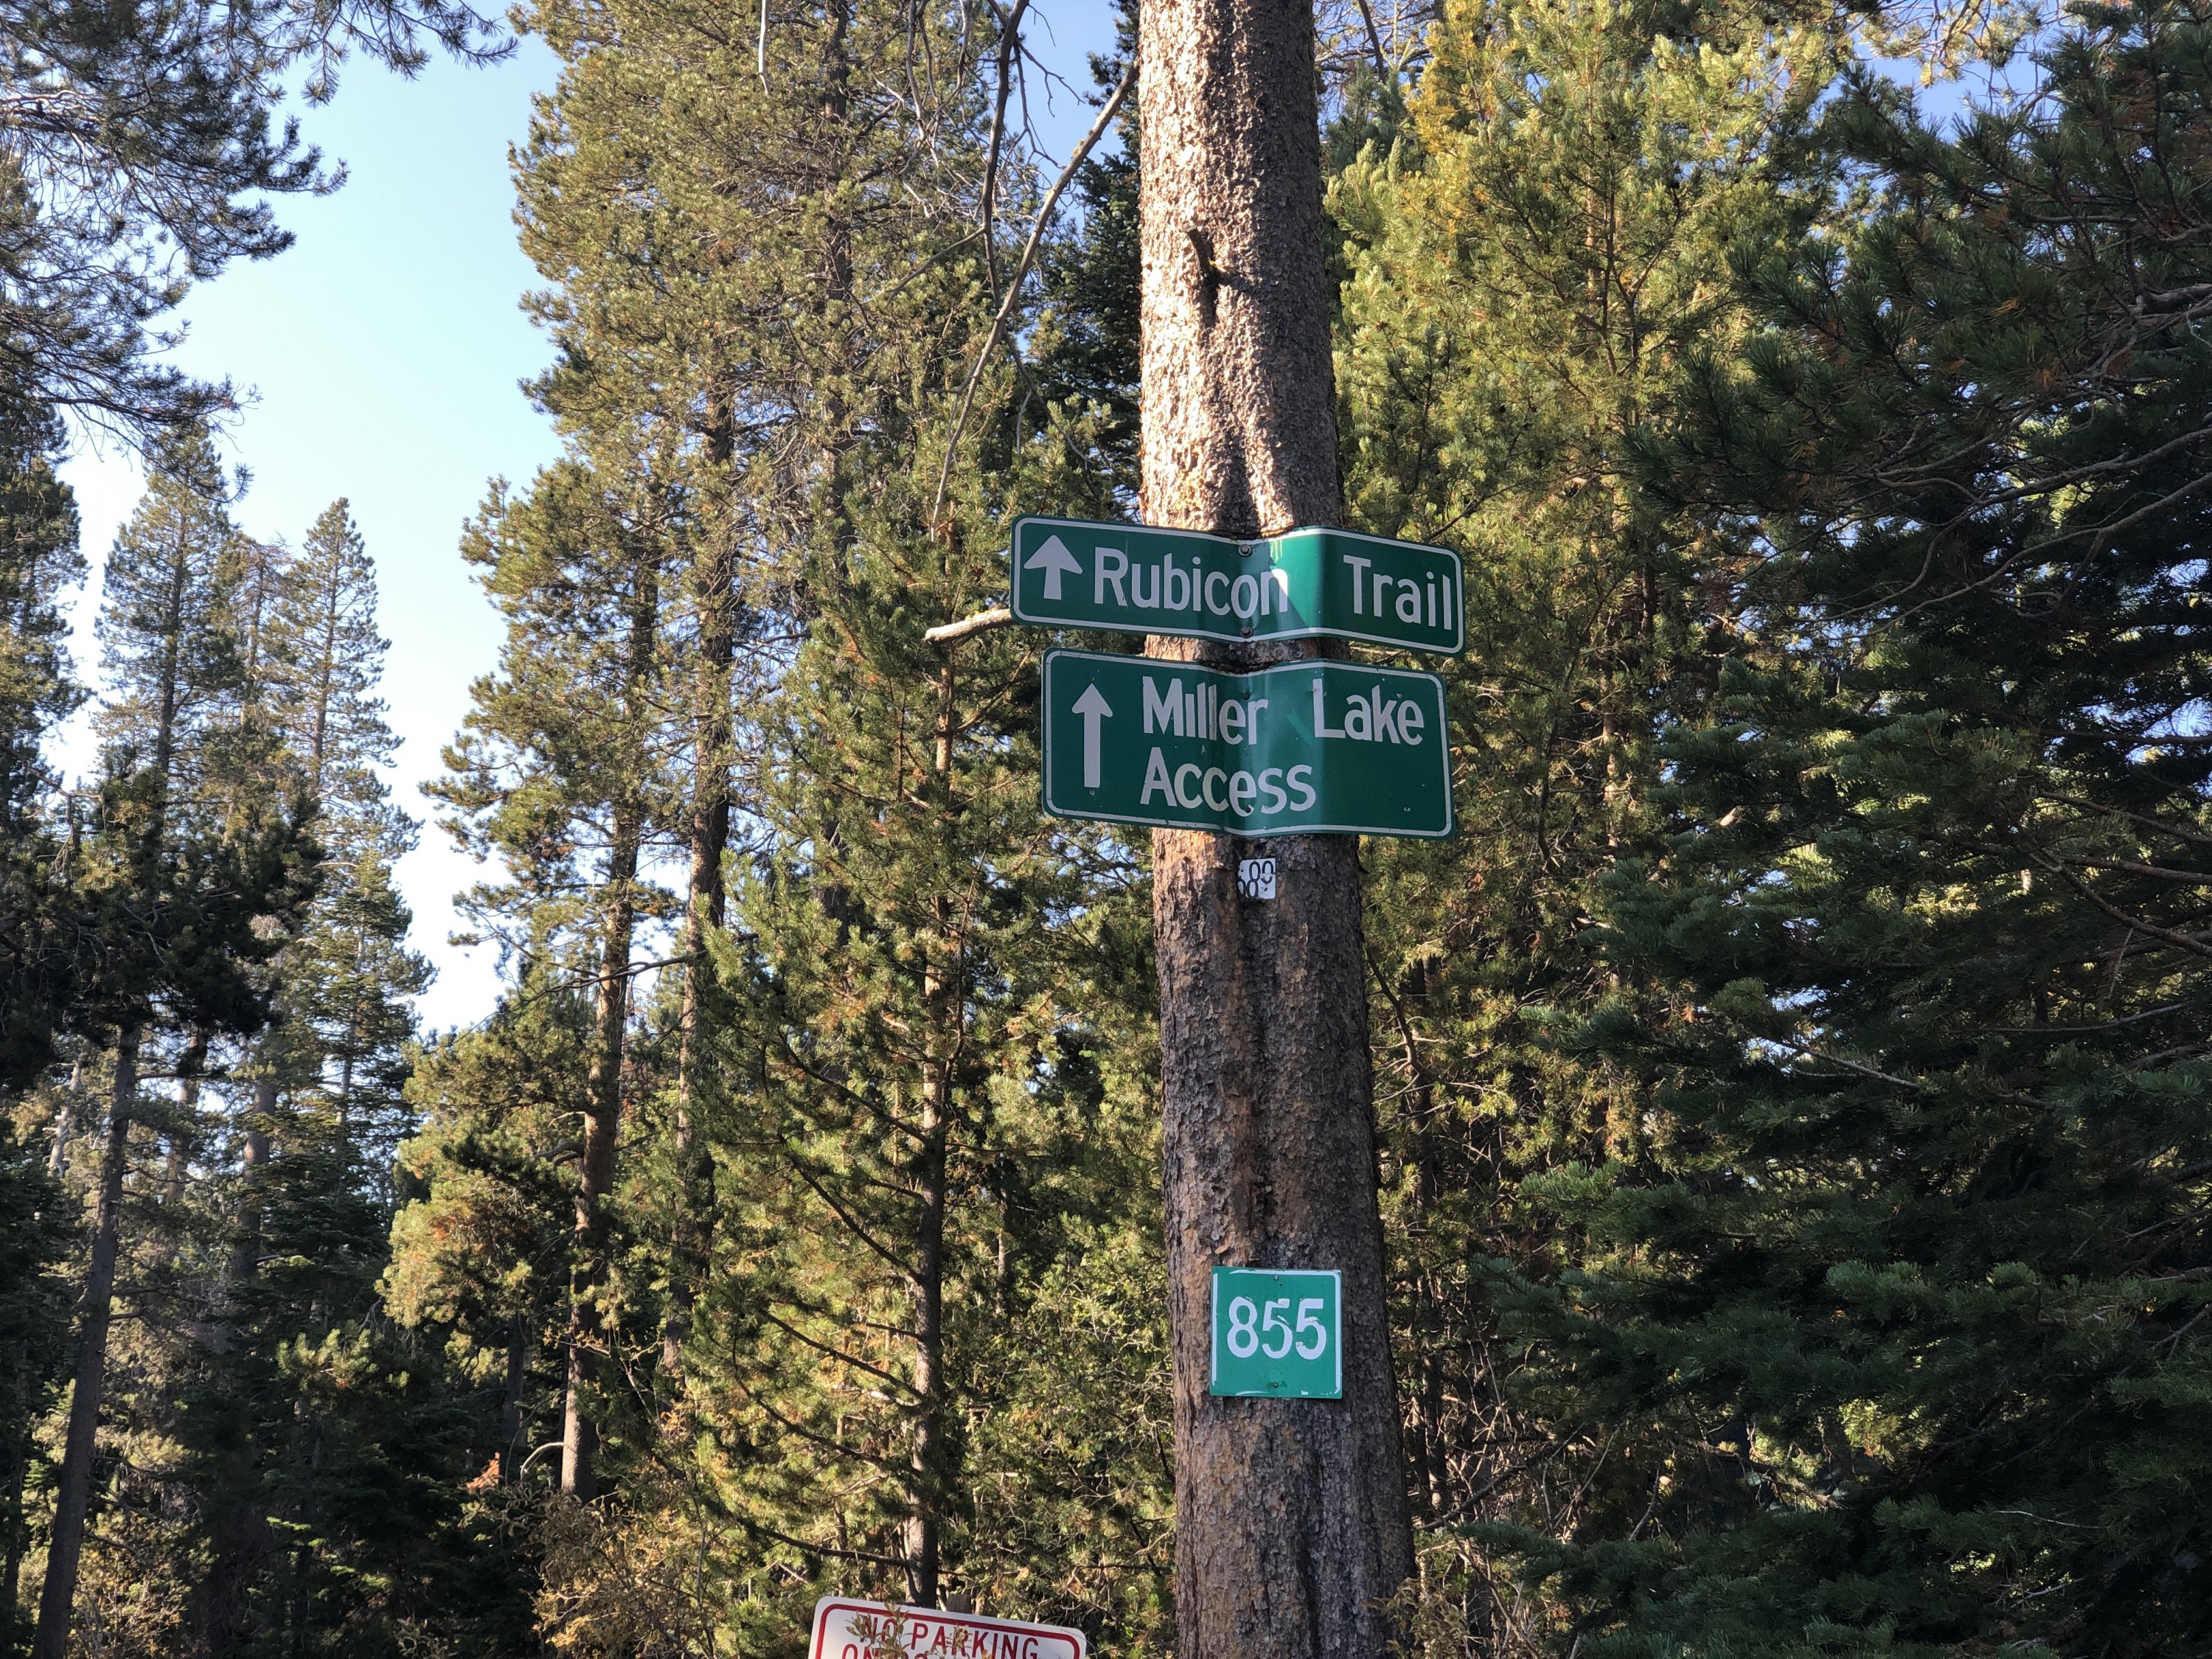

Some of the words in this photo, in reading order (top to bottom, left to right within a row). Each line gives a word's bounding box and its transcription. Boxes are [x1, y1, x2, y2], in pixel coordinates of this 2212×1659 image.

[1094, 546, 1289, 619] Rubicon
[1343, 554, 1453, 631] Trail
[1141, 675, 1269, 746] Miller
[1312, 678, 1425, 746] Lake
[1139, 746, 1318, 818] Access
[1226, 1295, 1327, 1360] 855
[859, 1615, 899, 1646] NO
[910, 1621, 1040, 1659] PARKING
